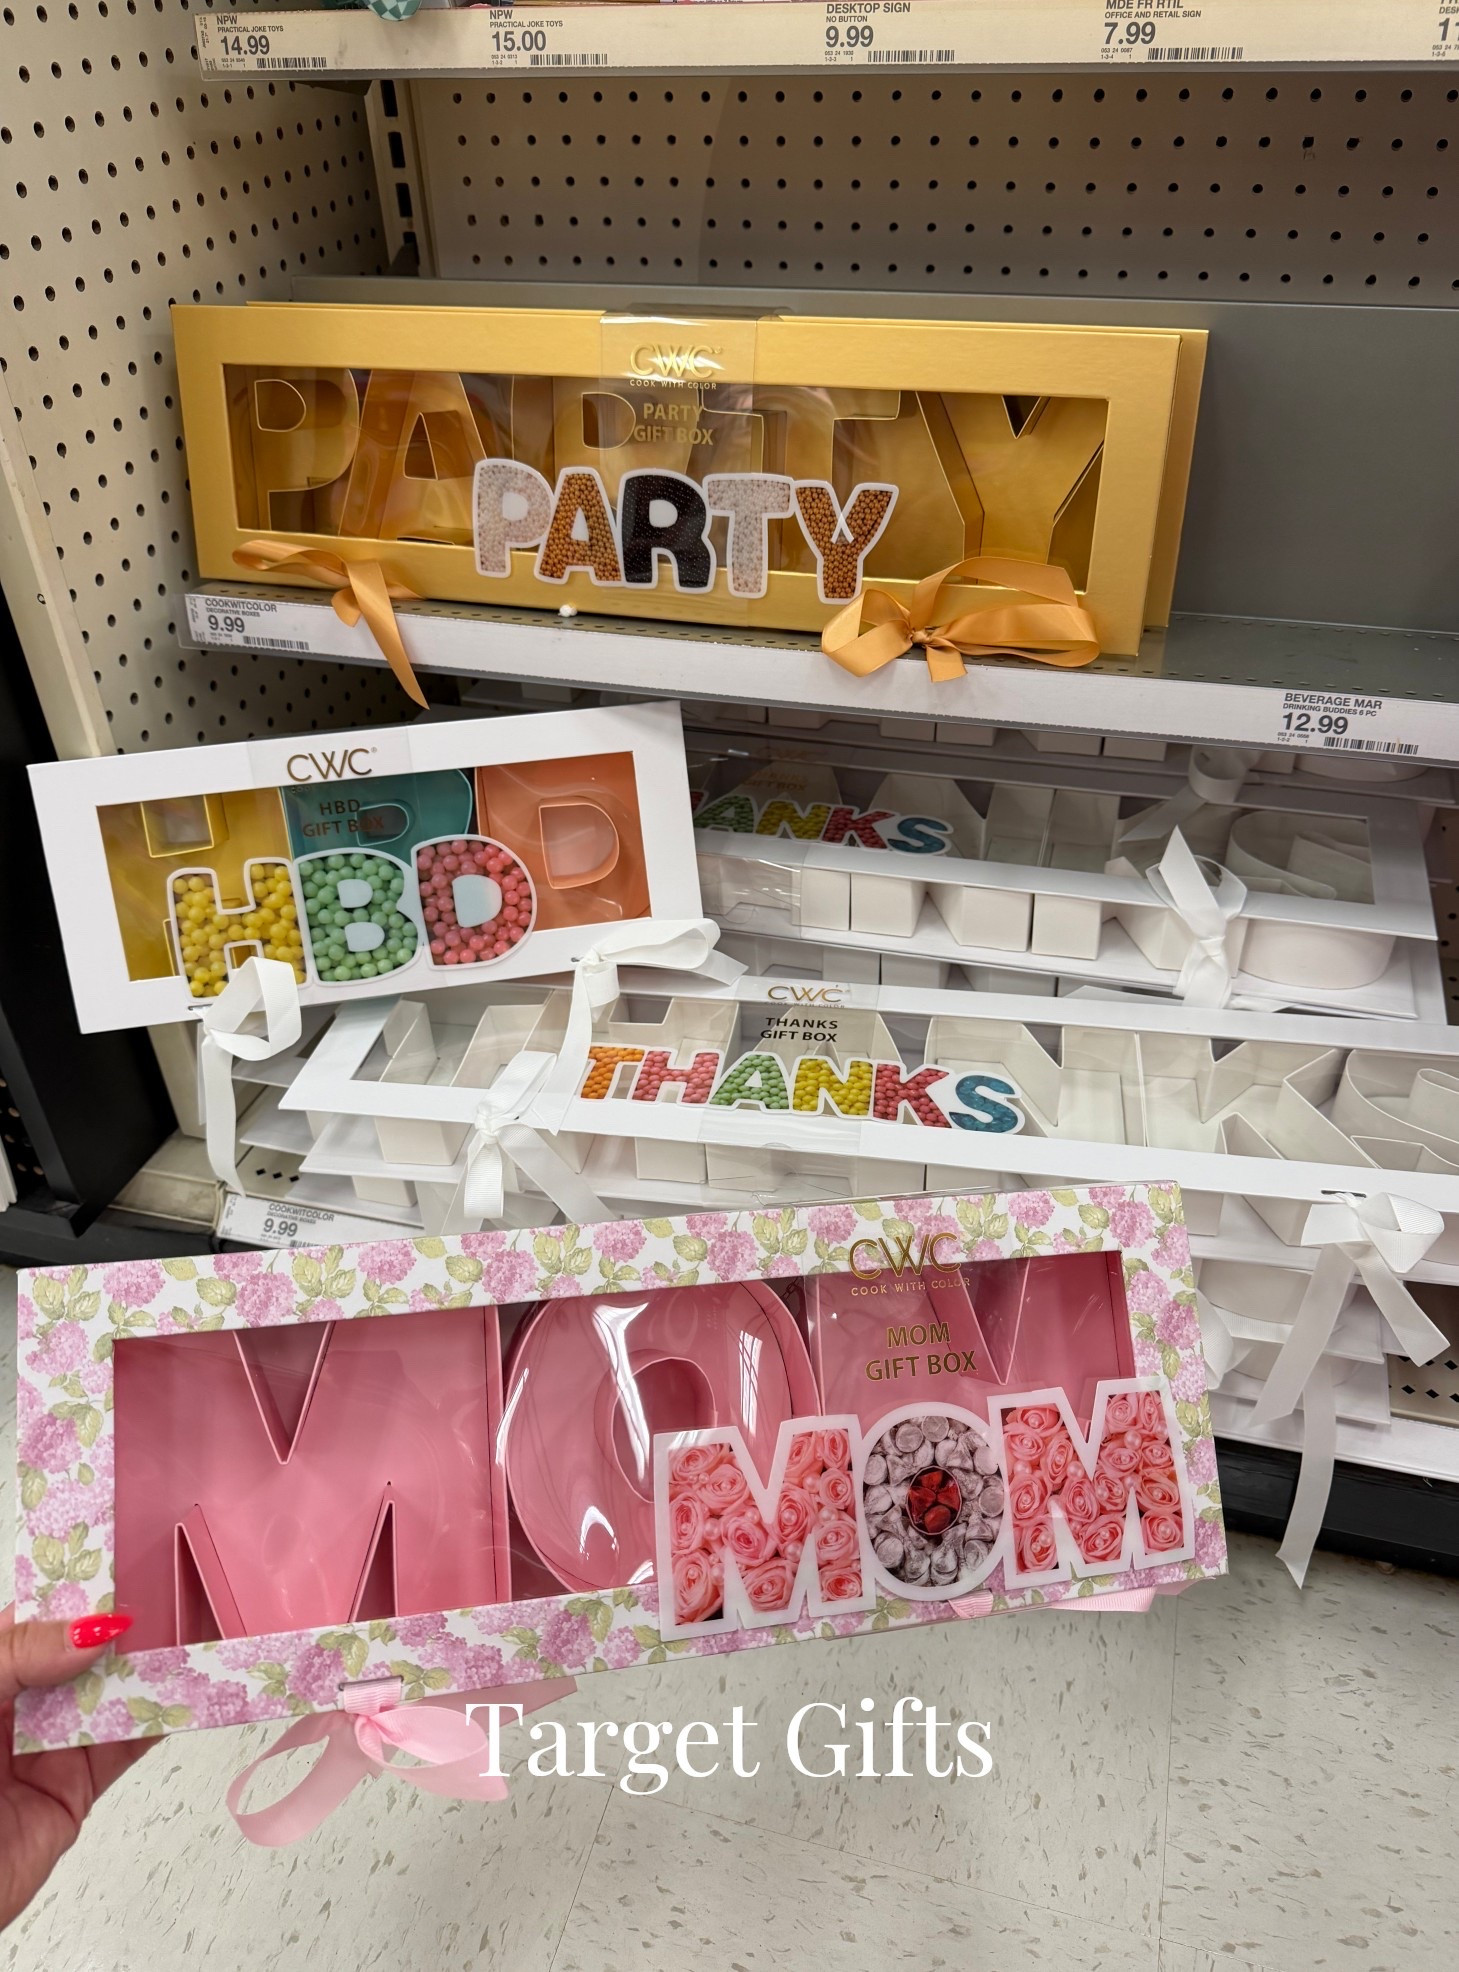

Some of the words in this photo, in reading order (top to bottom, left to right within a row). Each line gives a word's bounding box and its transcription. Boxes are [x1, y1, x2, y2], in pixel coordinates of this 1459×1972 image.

[826, 3, 880, 14] DESKTOP
[883, 2, 911, 13] SIGN
[1106, 0, 1134, 9] MDE
[1137, 0, 1153, 9] FR
[216, 15, 238, 25] NPW
[489, 10, 513, 20] NPW
[527, 20, 545, 28] JOKE
[838, 15, 868, 23] BUTTON
[1104, 11, 1133, 19] OFFICE
[1153, 10, 1180, 18] RETAIL
[1182, 10, 1202, 18] SIGN
[491, 30, 547, 52] 15.00
[825, 25, 874, 48] 9.99
[1104, 21, 1156, 45] 7.99
[220, 35, 270, 55] 14.99
[630, 343, 714, 378] CWC
[629, 379, 656, 388] COOK
[661, 380, 684, 389] WITH
[687, 381, 717, 390] COLOR
[643, 403, 703, 422] PARTY
[633, 425, 673, 443] GIFT
[676, 427, 714, 446] BOX
[473, 458, 899, 605] PARTY
[205, 598, 277, 613] COOKWITCOLOR
[208, 615, 245, 633] 9.99
[1282, 702, 1321, 712] DRINKING
[1322, 706, 1358, 715] BUDDIES
[1284, 693, 1352, 707] BEVERAGE
[1353, 698, 1383, 710] MAR
[1282, 712, 1349, 735] 12.99
[287, 748, 373, 782] CWC
[319, 799, 361, 816] HBD
[303, 820, 342, 838] GIFT
[167, 834, 538, 1004] HBD
[767, 985, 845, 1003] CWC
[766, 1017, 838, 1030] THANKS
[760, 1029, 799, 1040] GIFT
[802, 1032, 838, 1043] BOX
[576, 1045, 1026, 1135] THANKS
[268, 1203, 335, 1222] COOKWITCOLOR
[263, 1218, 298, 1237] 9.99
[849, 1232, 962, 1280] CWC
[851, 1284, 888, 1296] COOK
[894, 1281, 926, 1293] WITH
[931, 1277, 971, 1290] COLOR
[887, 1322, 951, 1349] MOM
[865, 1355, 920, 1381] GIFT
[927, 1350, 977, 1376] BOX
[653, 1376, 1195, 1639] MOM
